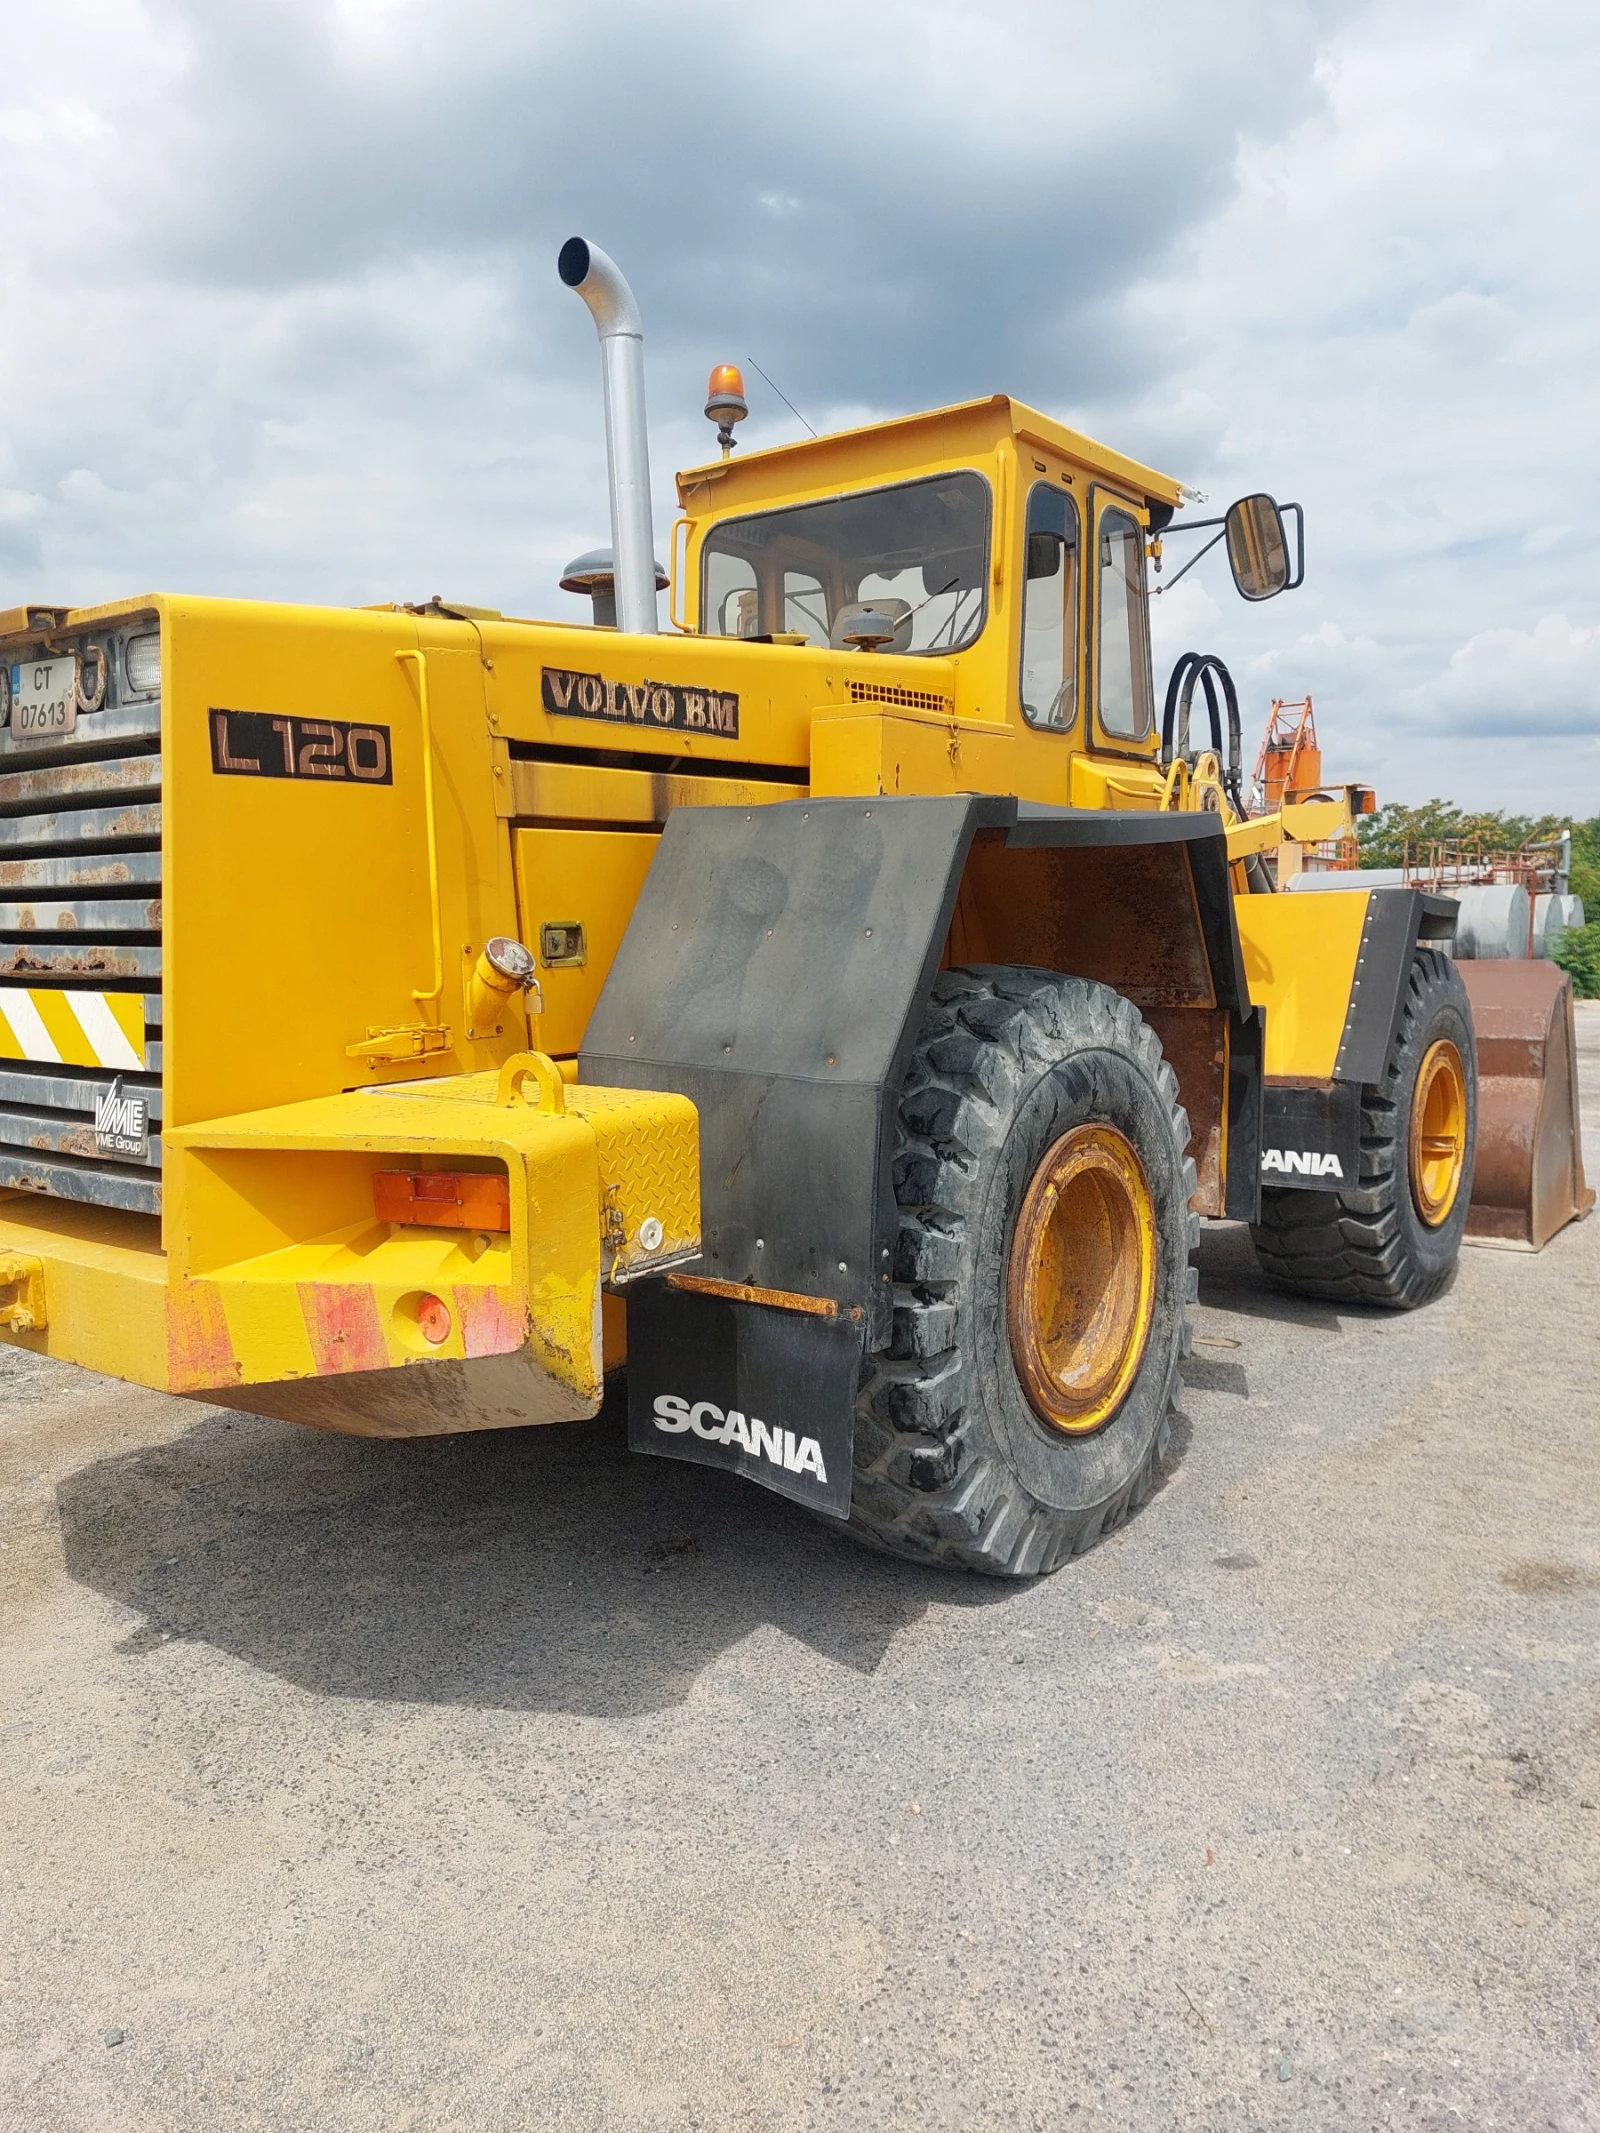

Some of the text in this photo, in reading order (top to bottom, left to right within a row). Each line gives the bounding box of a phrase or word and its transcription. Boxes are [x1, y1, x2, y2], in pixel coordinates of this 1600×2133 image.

[34, 666, 53, 691] CT
[543, 669, 737, 732] VOLVO BM
[20, 701, 66, 729] 07613
[216, 714, 387, 779] L 120
[95, 1074, 143, 1137] VME
[96, 1132, 142, 1154] VME Group
[1261, 1148, 1344, 1178] ANIA
[652, 1394, 827, 1484] SCANIA
